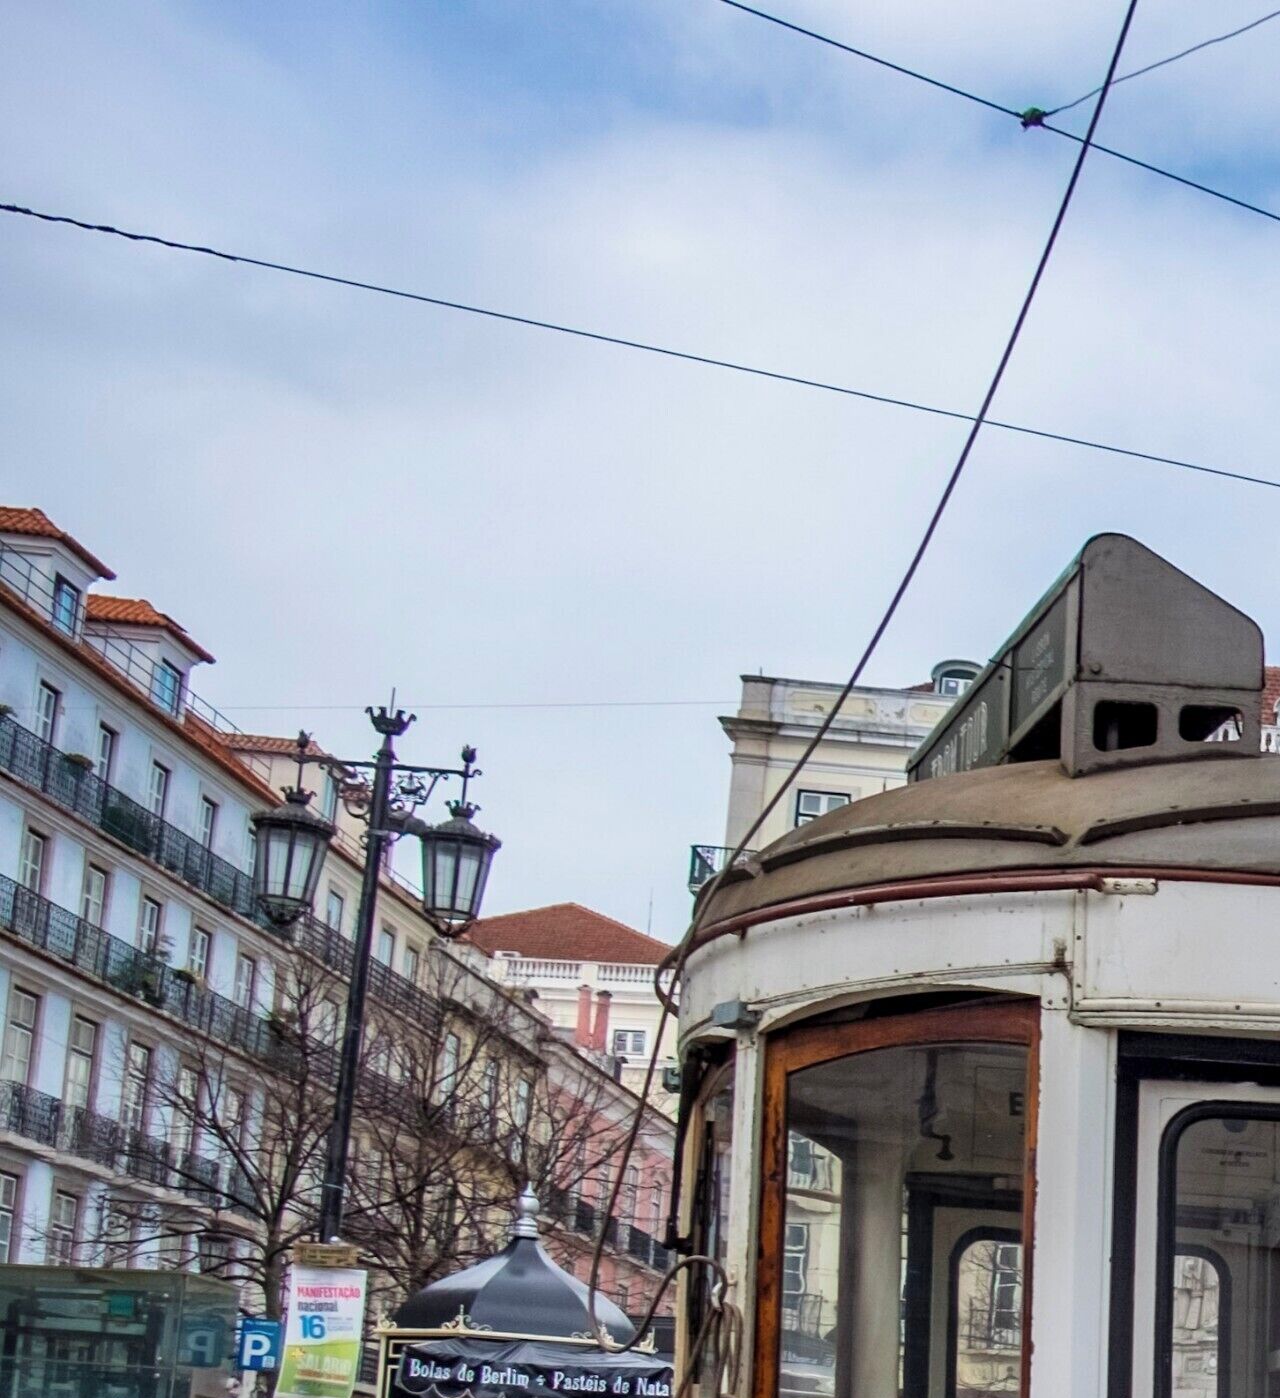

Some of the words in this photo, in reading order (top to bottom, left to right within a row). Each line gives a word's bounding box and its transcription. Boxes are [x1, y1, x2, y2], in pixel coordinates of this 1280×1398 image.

[297, 1285, 360, 1301] MANIFESTAÇÃO
[300, 1315, 326, 1339] 16
[242, 1334, 271, 1366] P
[410, 1358, 451, 1379] Bolas
[457, 1363, 475, 1382] de
[482, 1365, 529, 1389] Berlim
[552, 1371, 607, 1392] Pastéis
[613, 1376, 630, 1394] de
[636, 1377, 669, 1396] Nata
